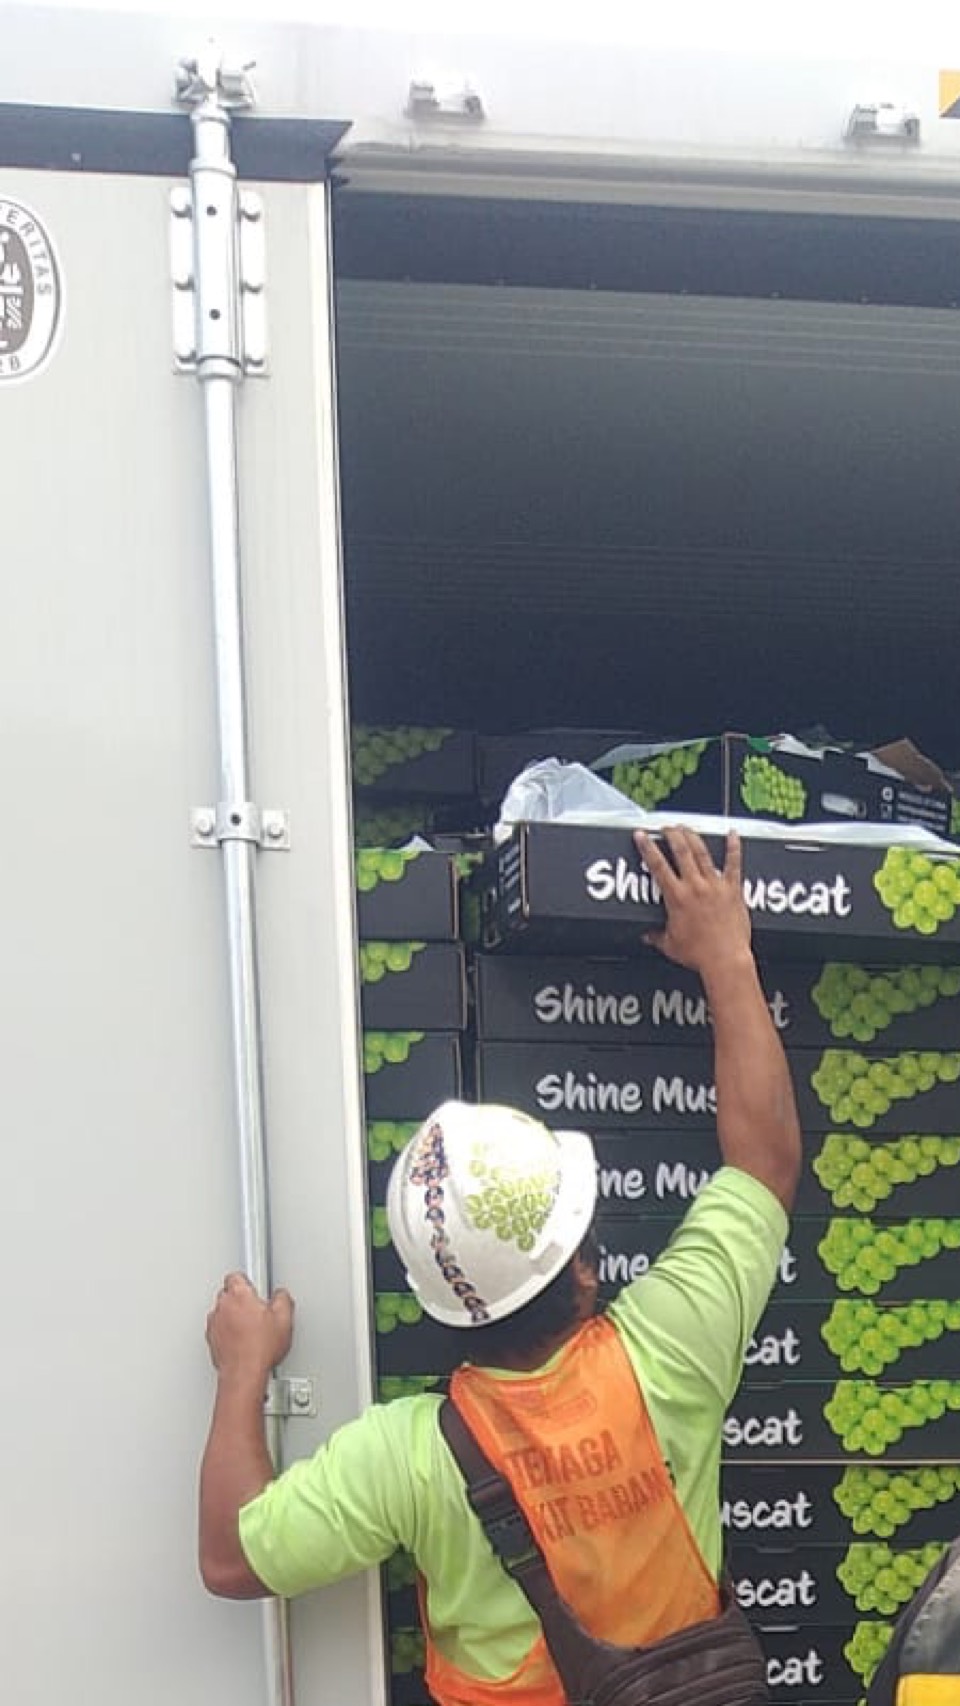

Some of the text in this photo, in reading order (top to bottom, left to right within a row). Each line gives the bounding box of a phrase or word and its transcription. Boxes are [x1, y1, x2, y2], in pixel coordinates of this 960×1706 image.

[0, 205, 51, 296] ERITAS
[586, 857, 852, 916] Shi uscat
[534, 984, 642, 1026] Shine
[535, 1071, 718, 1114] Shine Mus
[598, 1245, 651, 1283] ine
[744, 1327, 801, 1366] cat
[722, 1408, 803, 1446] scat
[504, 1429, 623, 1488] TENAGA
[576, 1466, 667, 1531] BARAN
[722, 1491, 812, 1529] scat
[735, 1570, 816, 1607] scat
[767, 1649, 823, 1686] cat
